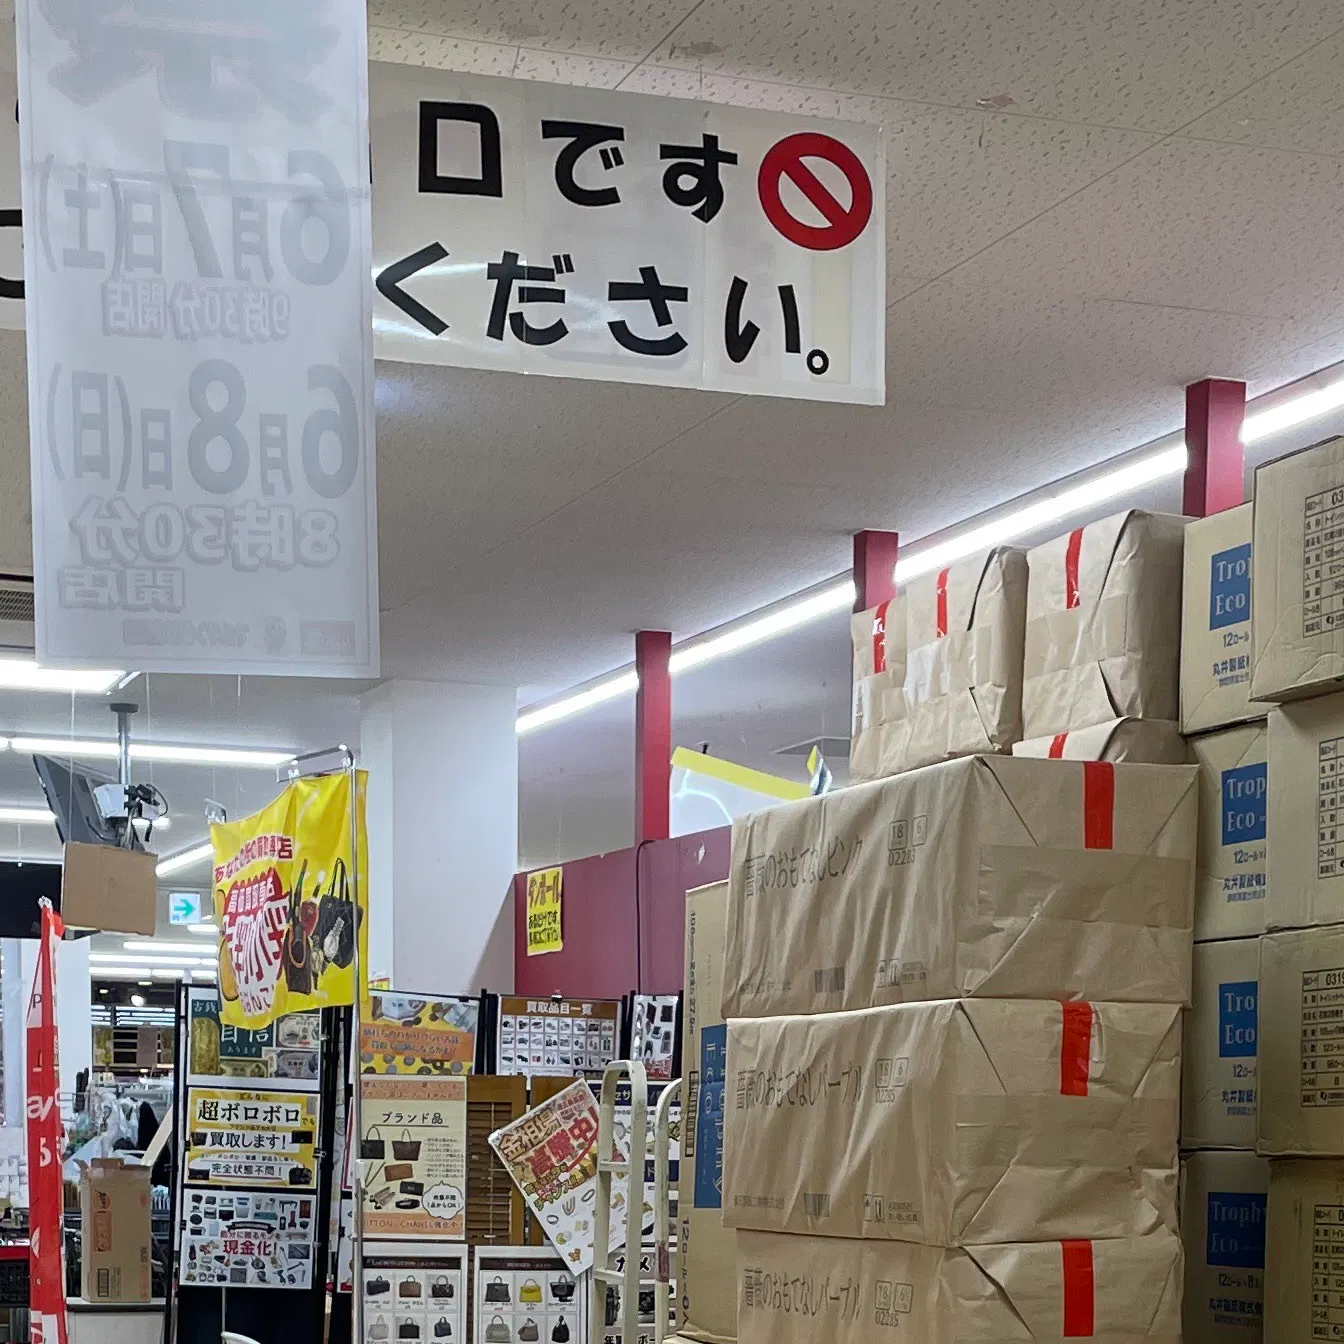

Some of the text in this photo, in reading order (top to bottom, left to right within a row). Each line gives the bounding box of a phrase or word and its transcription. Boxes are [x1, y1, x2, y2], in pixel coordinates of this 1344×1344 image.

[1215, 593, 1246, 615] Eco
[1227, 811, 1255, 831] Eco
[1224, 1024, 1255, 1043] Eco
[198, 1100, 300, 1121] 超ボロボロ
[382, 1112, 443, 1124] ブランド品
[210, 1131, 286, 1149] 買取します!
[499, 1109, 562, 1159] 金相場
